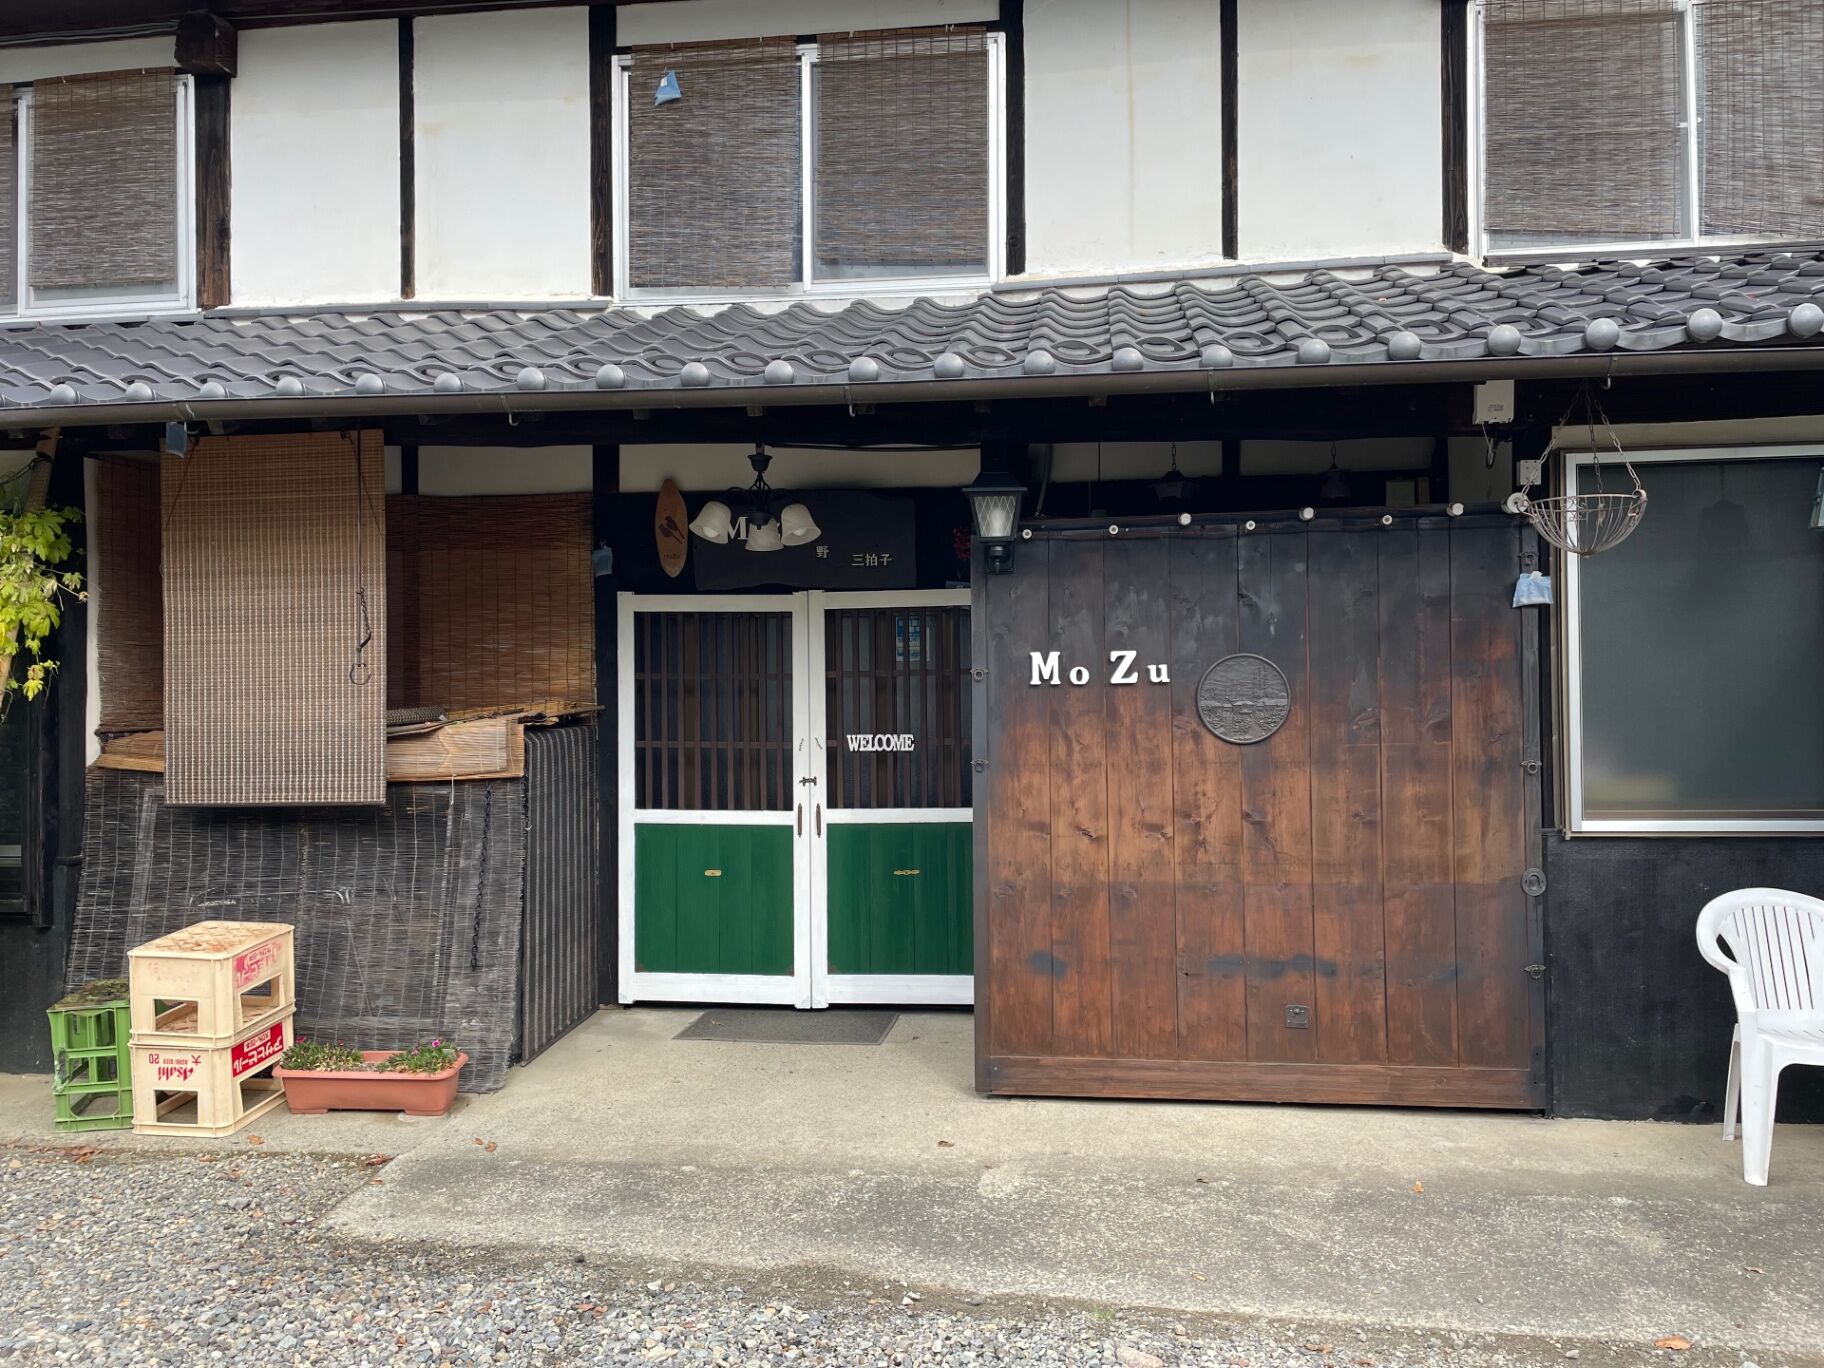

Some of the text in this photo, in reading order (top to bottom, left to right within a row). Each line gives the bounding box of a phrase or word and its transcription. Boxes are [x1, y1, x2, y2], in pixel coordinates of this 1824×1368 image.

[851, 553, 892, 567] 三拍子
[846, 733, 915, 752] WELCOME
[148, 1053, 160, 1064] 20
[233, 1035, 283, 1073] アサヒビール
[157, 1066, 194, 1082] Asahi
